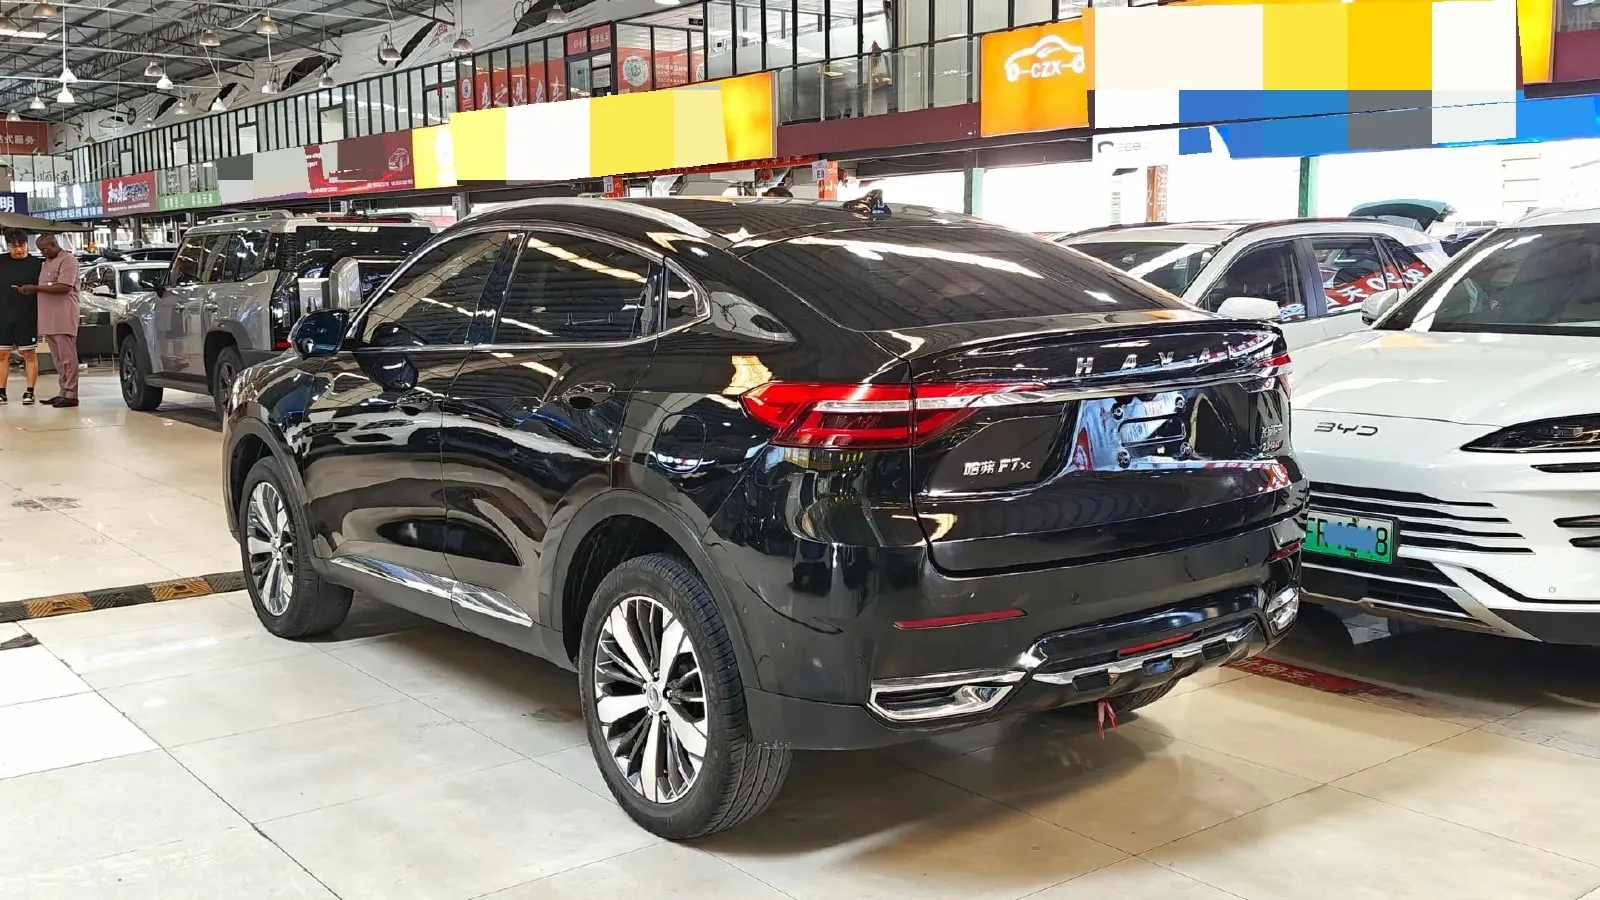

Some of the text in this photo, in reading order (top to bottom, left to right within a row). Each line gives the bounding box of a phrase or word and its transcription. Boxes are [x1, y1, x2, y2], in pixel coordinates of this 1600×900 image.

[1030, 60, 1062, 79] CZX
[1075, 345, 1239, 375] HAVAL
[1314, 421, 1378, 436] BYD
[963, 460, 996, 476] 哈弗
